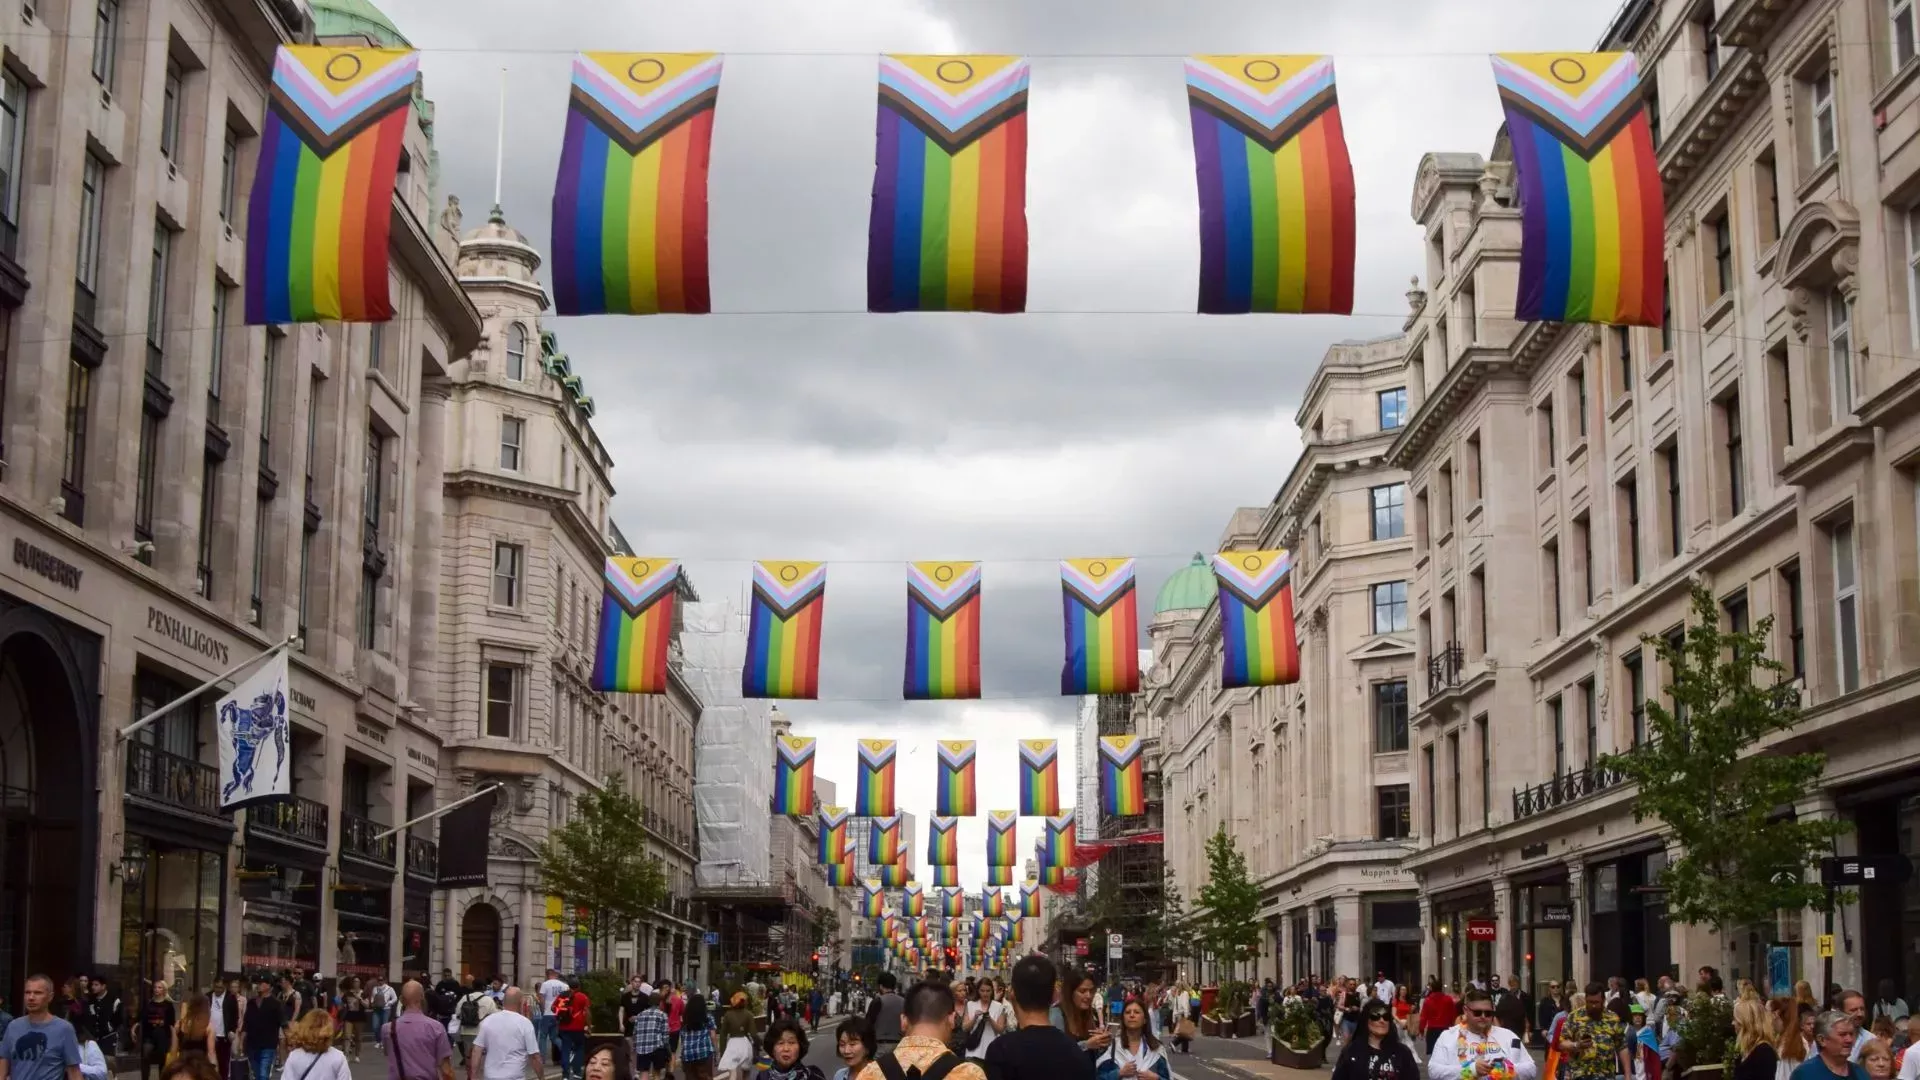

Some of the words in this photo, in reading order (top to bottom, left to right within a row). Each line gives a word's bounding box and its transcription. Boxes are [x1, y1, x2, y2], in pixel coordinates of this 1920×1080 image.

[13, 537, 83, 593] BURBERRY
[147, 606, 229, 665] PENHALIGON'S
[1361, 867, 1391, 879] Mappin
[1820, 936, 1831, 955] H
